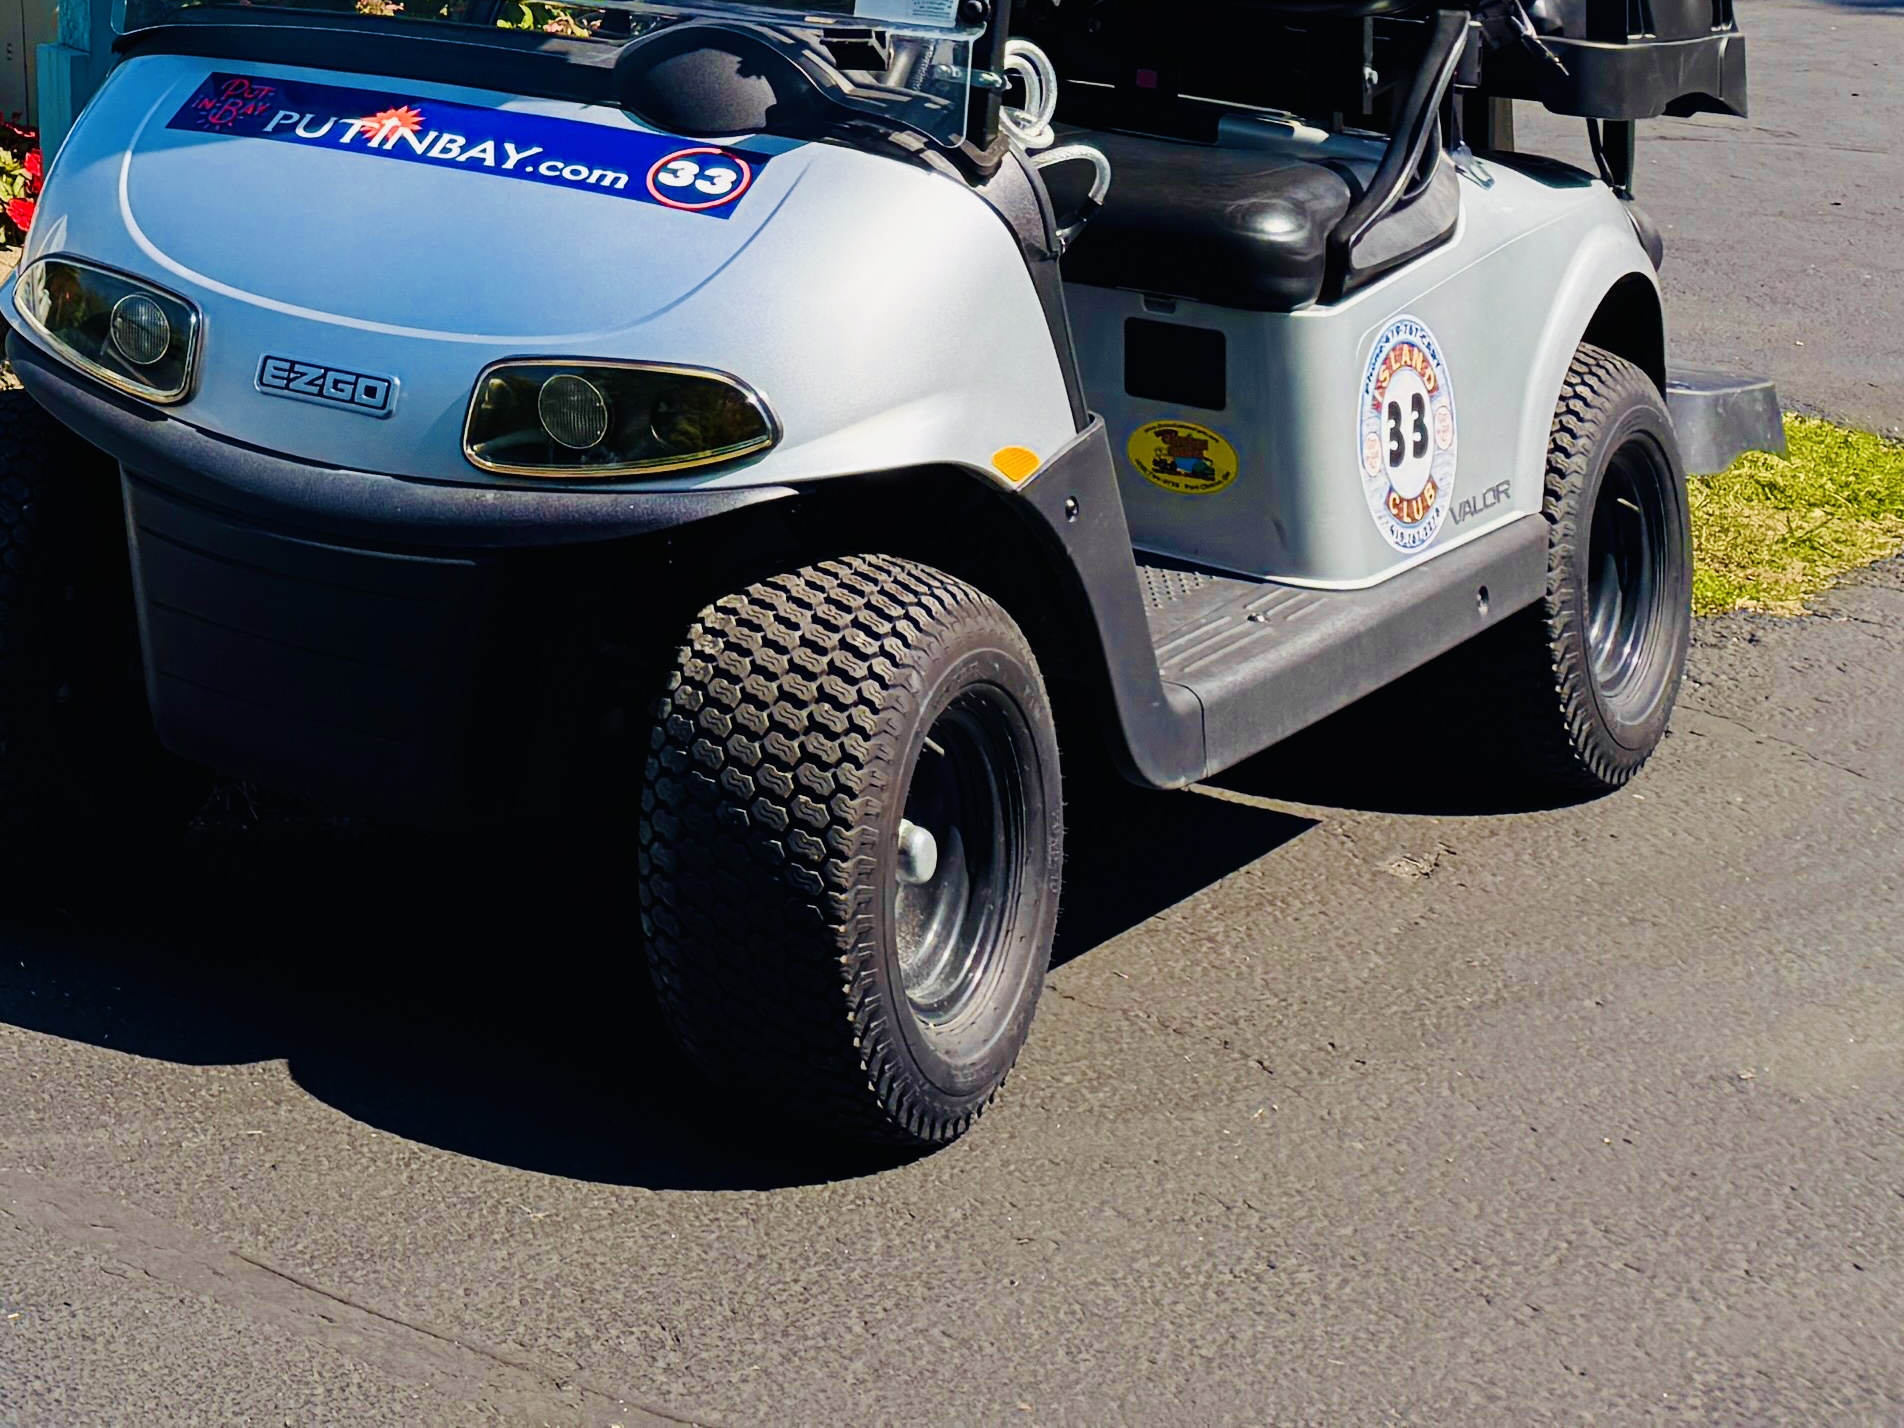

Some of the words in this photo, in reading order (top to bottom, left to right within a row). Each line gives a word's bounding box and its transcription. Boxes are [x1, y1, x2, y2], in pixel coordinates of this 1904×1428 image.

[658, 160, 738, 196] 33
[261, 358, 388, 408] EZGO
[1374, 343, 1435, 403] ISLAND
[1388, 392, 1429, 467] 33
[1389, 482, 1434, 523] CLUB
[1450, 480, 1511, 525] VALOR
